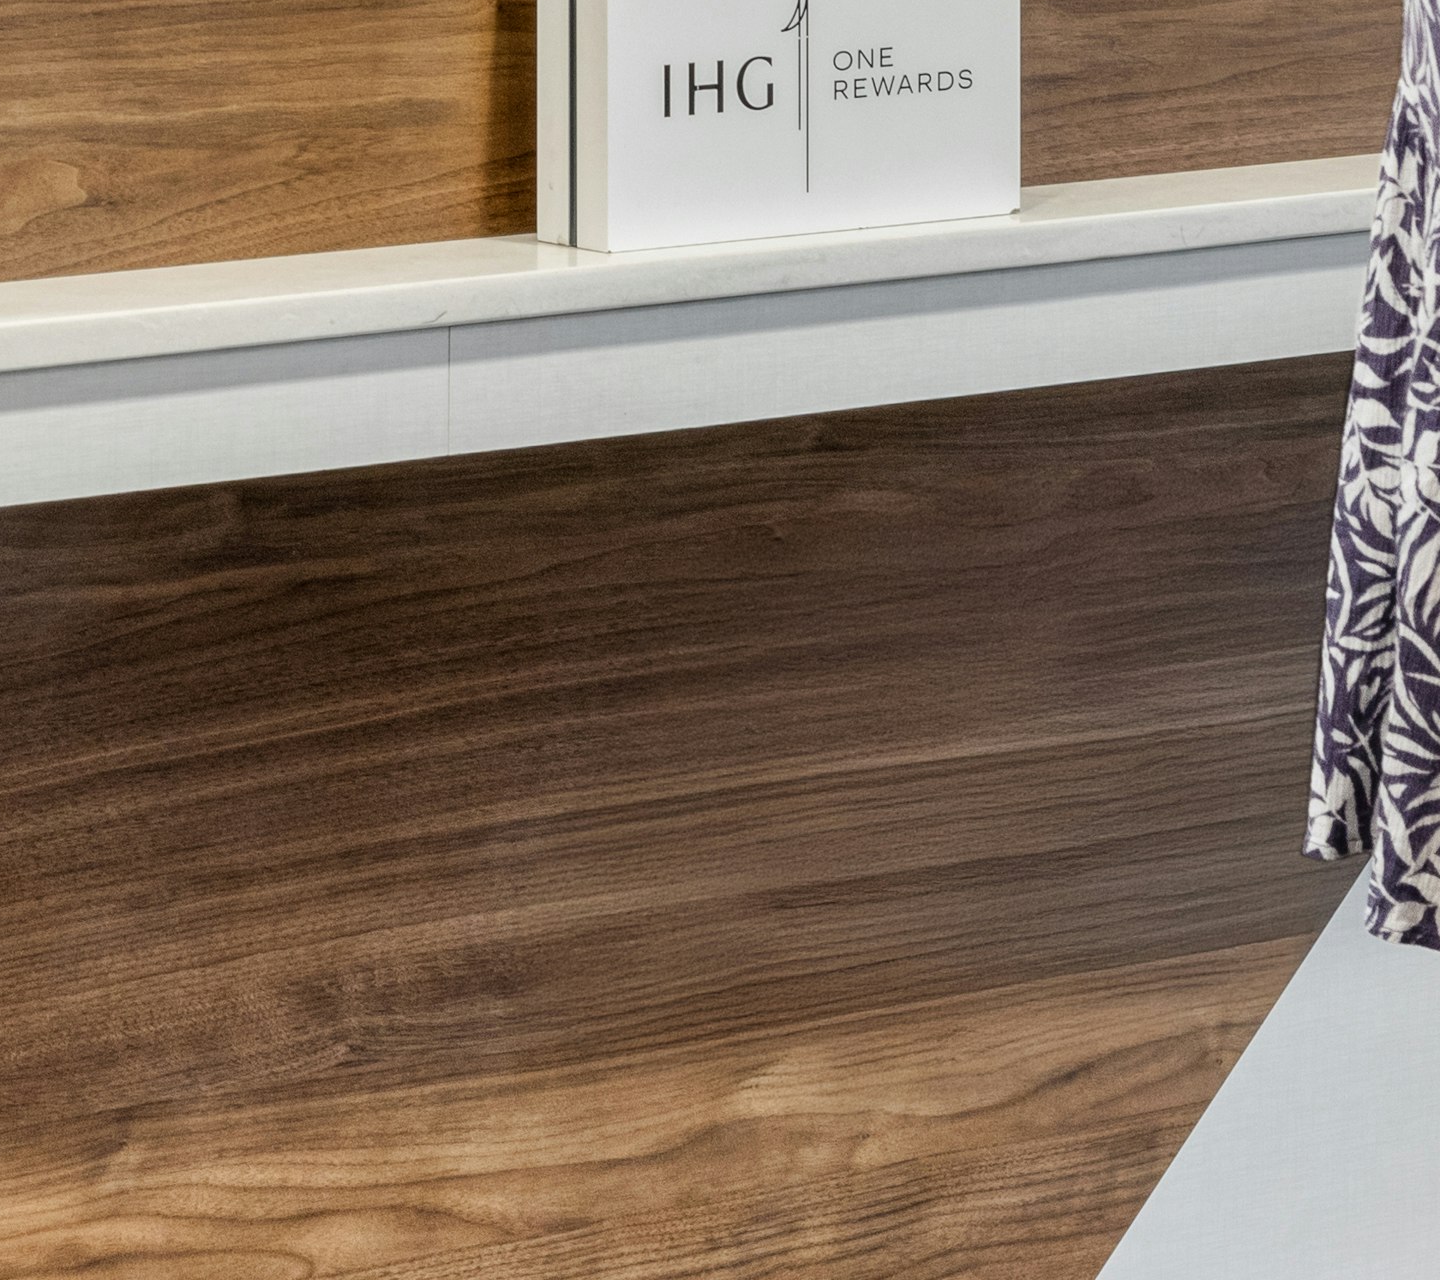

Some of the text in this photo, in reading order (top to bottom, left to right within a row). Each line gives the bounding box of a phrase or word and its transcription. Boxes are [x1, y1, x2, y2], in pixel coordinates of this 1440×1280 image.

[832, 47, 894, 72] ONE
[663, 55, 775, 118] IHG
[833, 69, 974, 101] REWARDS
